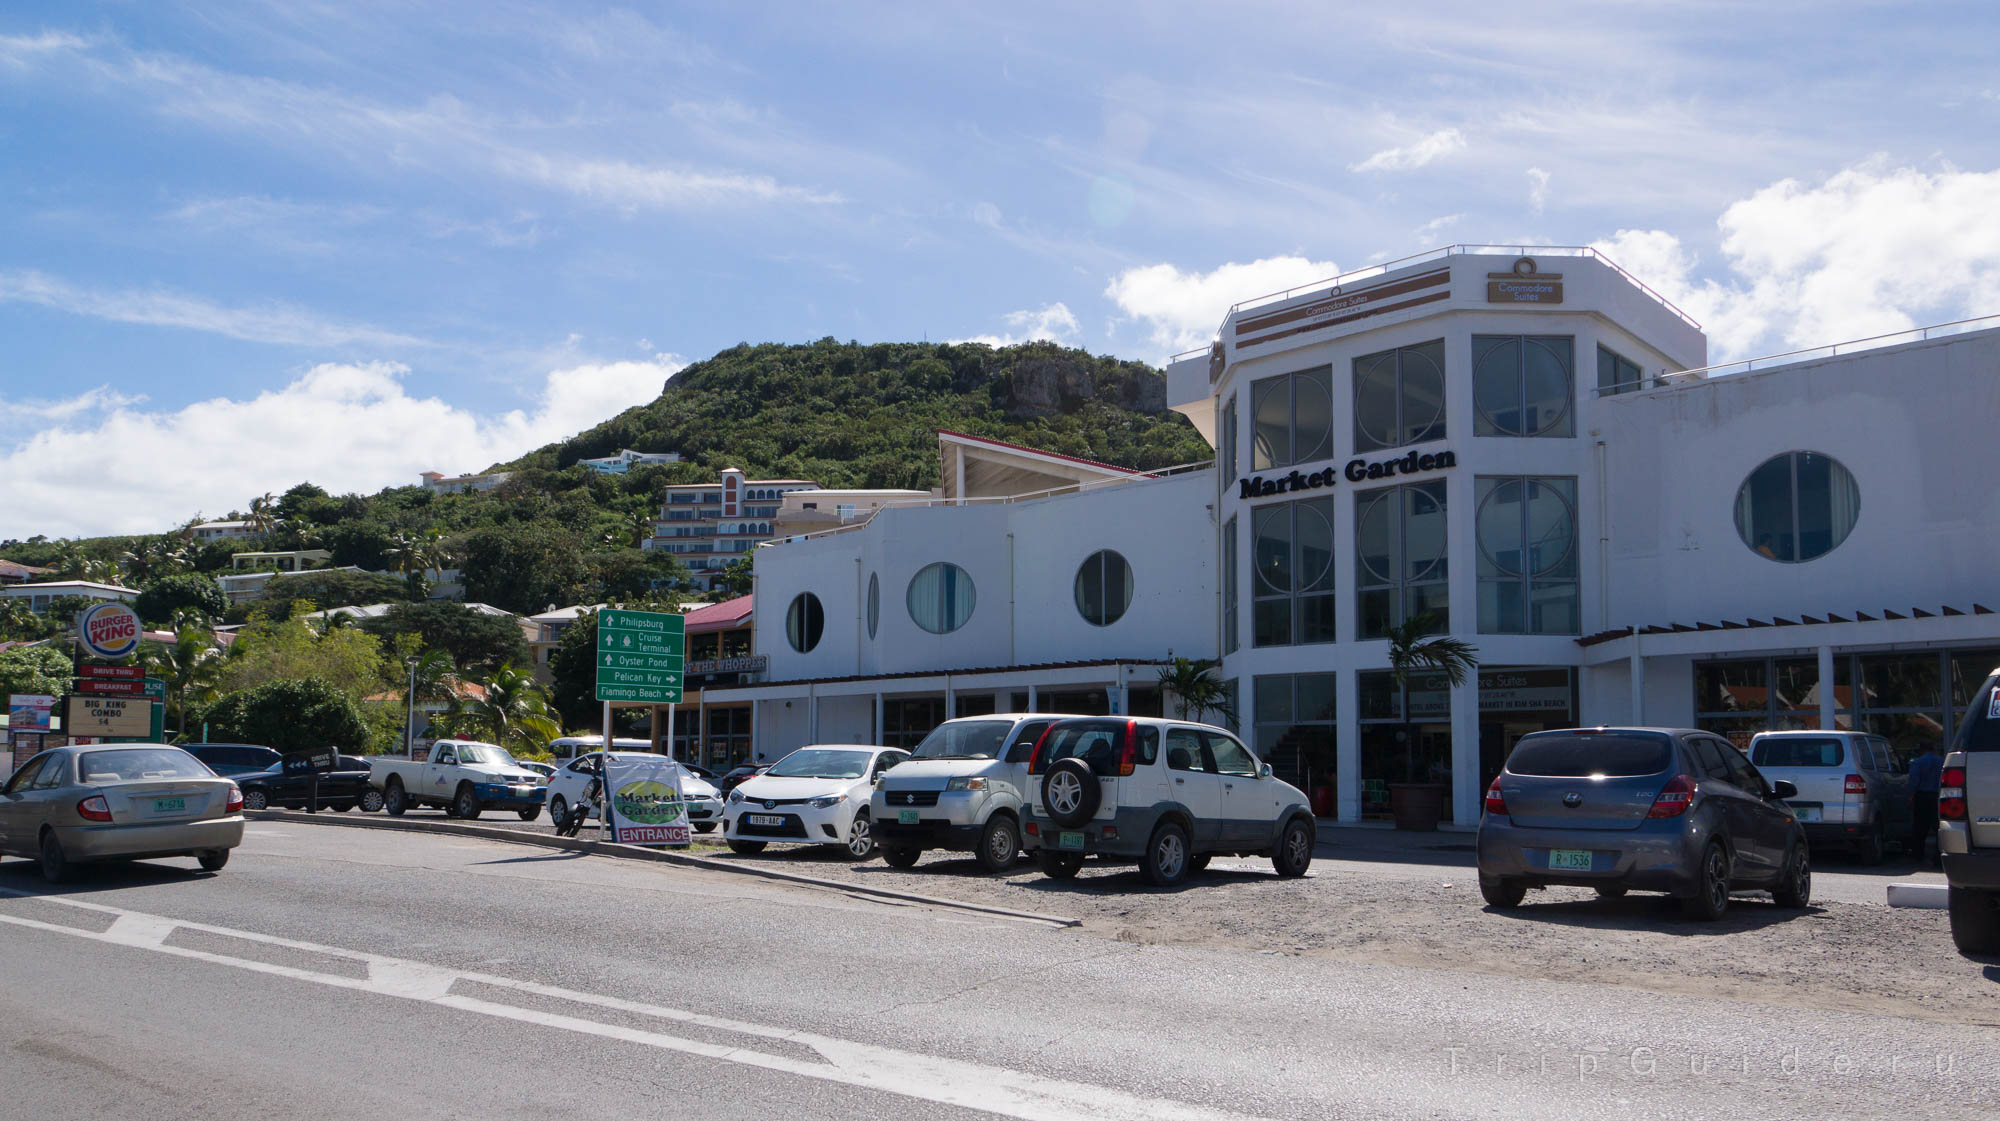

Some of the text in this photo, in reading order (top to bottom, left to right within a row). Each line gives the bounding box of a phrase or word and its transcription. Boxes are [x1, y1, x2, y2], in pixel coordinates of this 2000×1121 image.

[1499, 282, 1553, 293] Commodore
[1514, 292, 1539, 301] Suites
[1306, 299, 1348, 316] Commodore
[1349, 295, 1368, 306] Suites
[1239, 450, 1457, 499] Market Garden
[90, 615, 133, 632] BURGER
[620, 616, 664, 631] Philipsburg
[92, 624, 135, 644] KING
[638, 633, 662, 642] Cruise
[639, 643, 671, 653] Terminal
[619, 656, 668, 667] Oyster Pond
[718, 657, 765, 672] WHOPPER
[93, 667, 134, 676] DRIVE THRU
[614, 672, 662, 684] Pelican Key
[93, 683, 132, 691] BREAKFAST
[639, 689, 662, 698] Beach
[85, 700, 127, 709] BIG KING
[91, 709, 122, 717] COMBO
[311, 753, 330, 762] DRIVE
[313, 760, 330, 768] THRU
[620, 792, 677, 804] Market
[621, 805, 680, 816] Garden
[621, 828, 689, 841] ENTRANCE
